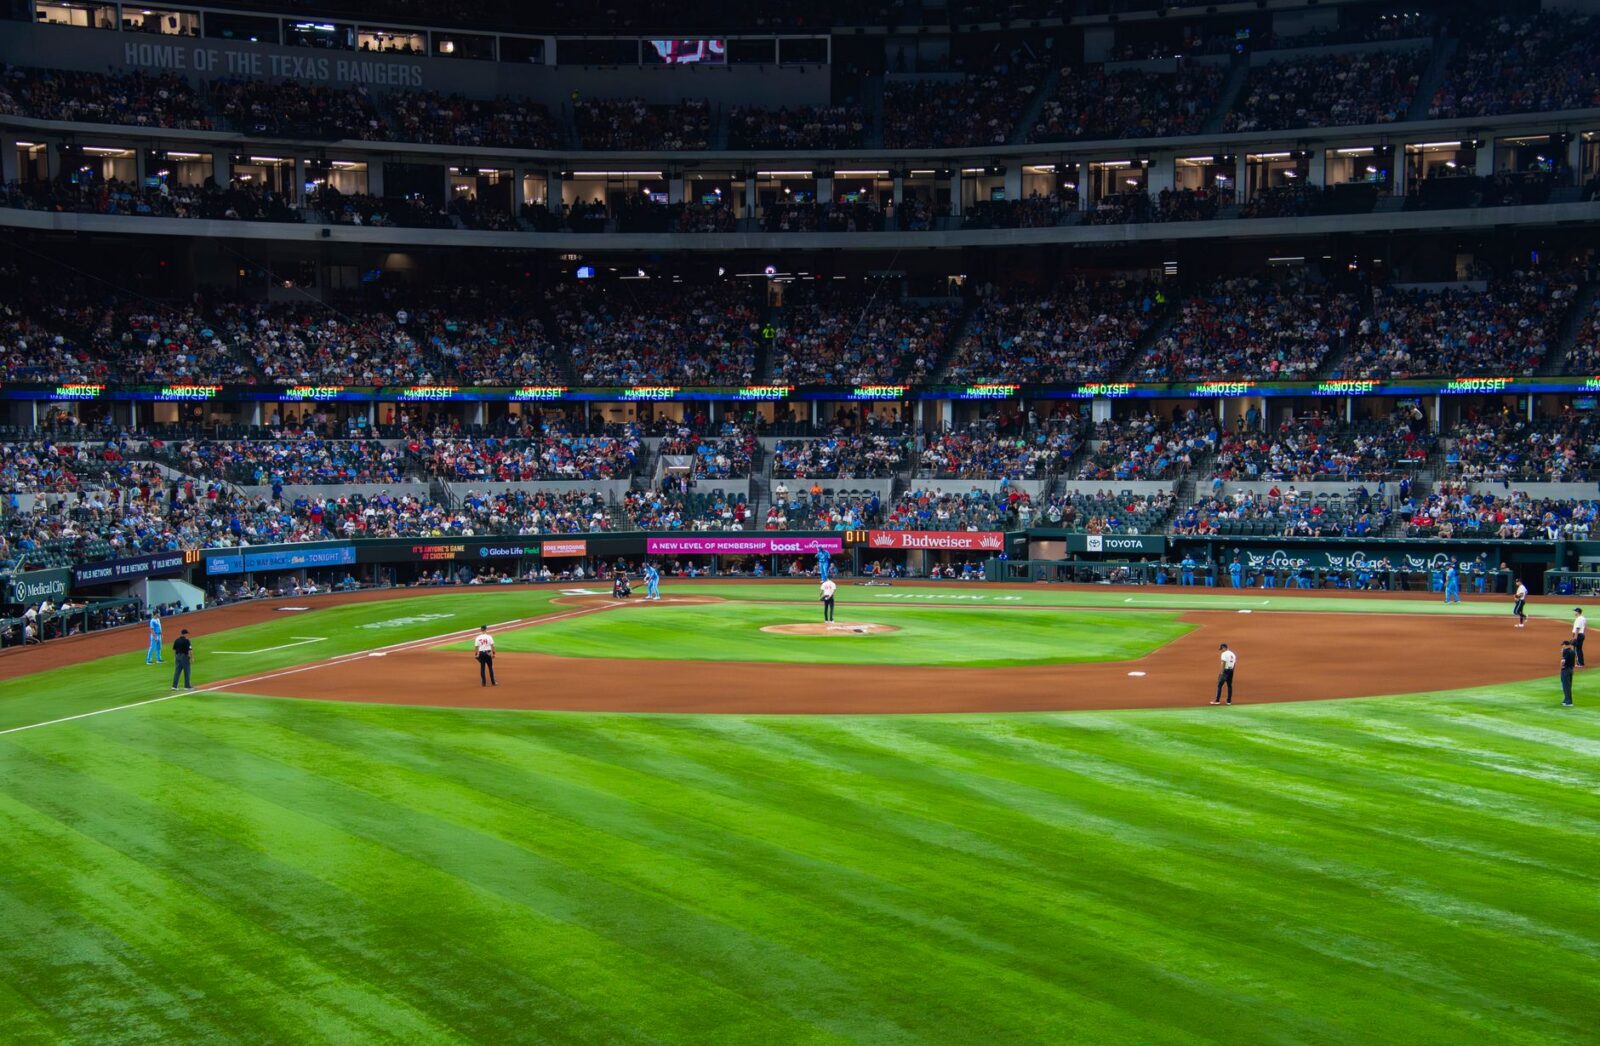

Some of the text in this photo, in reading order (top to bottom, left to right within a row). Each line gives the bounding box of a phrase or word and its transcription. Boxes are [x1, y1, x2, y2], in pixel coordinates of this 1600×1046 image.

[124, 42, 422, 87] HOME OF THE TEXAS RANGERS
[902, 534, 972, 547] Budweiser
[1105, 540, 1143, 548] TOYOTA
[309, 553, 339, 562] TONIGHT
[489, 548, 509, 556] Globe
[27, 580, 65, 597] Medical City
